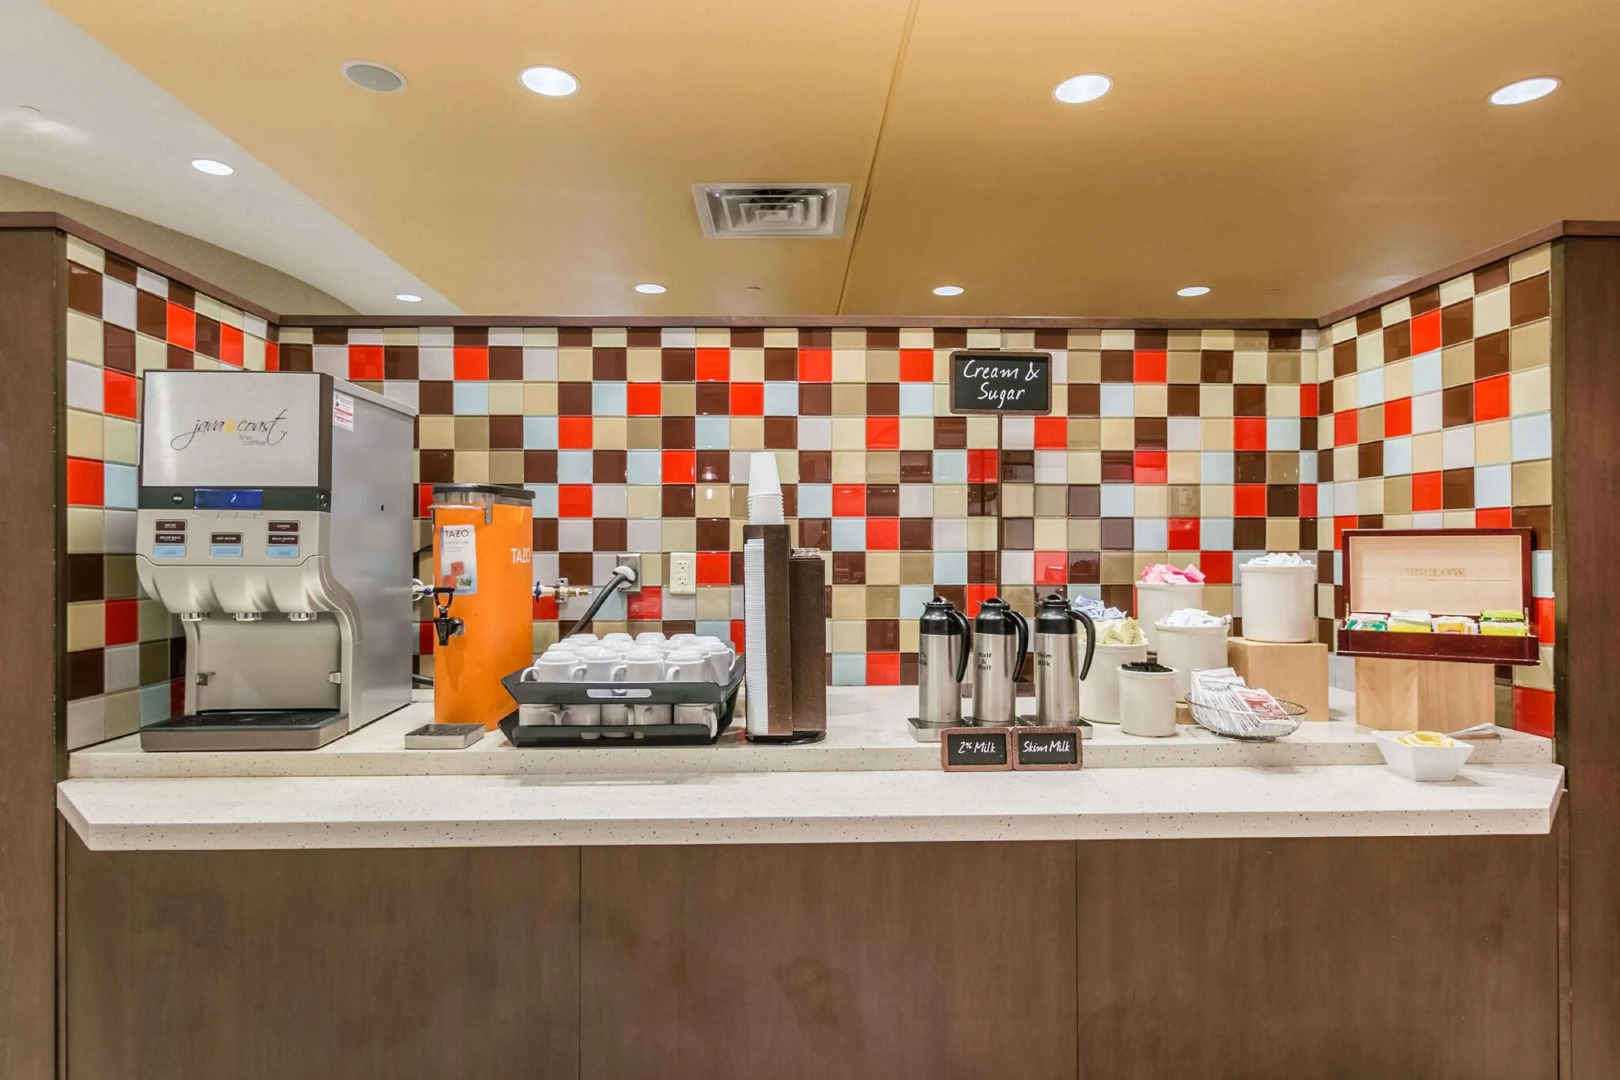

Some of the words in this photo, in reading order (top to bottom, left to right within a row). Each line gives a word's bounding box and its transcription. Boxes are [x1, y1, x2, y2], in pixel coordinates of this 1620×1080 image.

[963, 359, 1019, 380] Cream
[1024, 361, 1040, 381] &
[977, 381, 1026, 408] Sugar
[170, 418, 225, 451] java
[237, 408, 288, 446] coast
[444, 529, 469, 538] TAZO
[511, 547, 531, 564] TAZO
[958, 741, 972, 754] 2%
[973, 741, 996, 754] Milk
[1022, 740, 1048, 753] Skim
[1049, 740, 1070, 753] Milk
